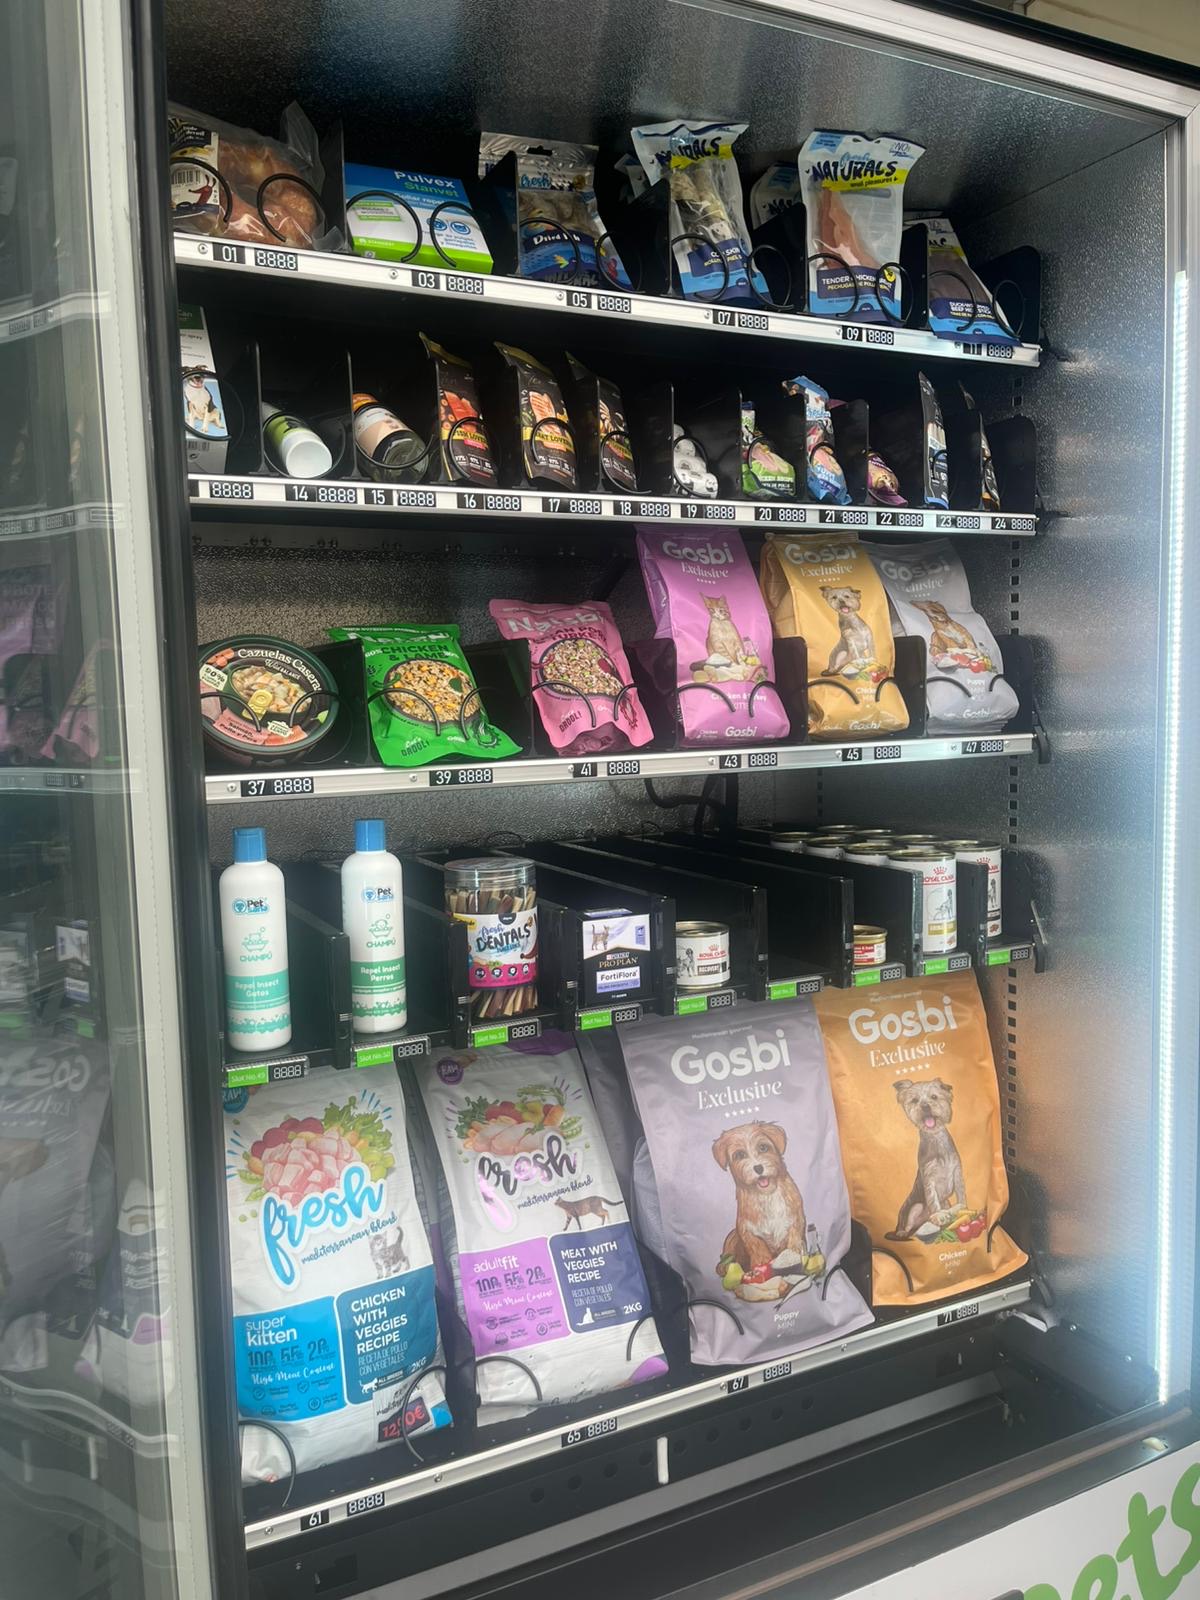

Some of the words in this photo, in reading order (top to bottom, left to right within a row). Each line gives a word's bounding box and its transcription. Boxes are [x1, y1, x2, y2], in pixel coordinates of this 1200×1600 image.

[812, 160, 898, 181] NATURALS
[394, 171, 456, 188] Pulvex
[404, 181, 458, 197] Stanvet
[222, 245, 237, 262] 01
[256, 249, 297, 270] 8888
[418, 272, 436, 288] 03
[447, 275, 483, 293] 8888
[821, 275, 850, 285] TENDER
[572, 292, 588, 307] 05
[599, 296, 631, 312] 8888
[718, 311, 732, 325] 07
[740, 314, 768, 329] 8888
[846, 327, 859, 341] 09
[867, 330, 893, 344] 8888
[988, 345, 1012, 358] 8888
[211, 482, 252, 498] 8888
[292, 485, 309, 501] 14
[318, 487, 356, 503] 8888
[372, 489, 386, 504] 15
[399, 491, 435, 507] 8888
[464, 495, 477, 508] 16
[487, 496, 520, 510] 8888
[549, 498, 561, 511] 17
[570, 499, 601, 514] 8888
[619, 501, 632, 515] 18
[640, 503, 670, 517] 8888
[686, 504, 698, 517] 19
[707, 504, 734, 519] 8888
[759, 507, 772, 521] 20
[779, 508, 805, 522] 8888
[825, 510, 836, 523] 21
[842, 511, 868, 524] 8888
[880, 512, 892, 525] 22
[898, 514, 923, 526] 8888
[940, 515, 952, 527] 23
[956, 516, 979, 528] 8888
[995, 517, 1006, 529] 24
[1011, 518, 1033, 531] 8888
[662, 541, 733, 565] Gosbi
[784, 544, 857, 565] Gosbi
[681, 561, 728, 579] Exclusive
[800, 564, 854, 578] Exclusive
[880, 559, 951, 580] Gosbi
[238, 649, 292, 664] Cazuelas
[381, 644, 449, 655] CHICKEN
[725, 726, 758, 737] Gosbi
[849, 720, 881, 731] Gosbi
[847, 749, 859, 760] 45
[876, 747, 900, 759] 8888
[966, 742, 977, 753] 47
[980, 740, 1003, 751] 8888
[580, 763, 592, 776] 41
[609, 761, 639, 774] 8888
[723, 755, 738, 768] 43
[750, 754, 777, 767] 8888
[436, 771, 452, 784] 39
[459, 769, 492, 783] 8888
[248, 781, 265, 795] 37
[274, 778, 312, 793] 8888
[247, 899, 264, 908] Pet
[366, 938, 396, 948] CHAMPÚ
[476, 923, 531, 953] DENTALS
[361, 966, 381, 976] Repel
[382, 964, 400, 973] Insect
[370, 974, 395, 982] Perros
[883, 968, 901, 980] 8888
[257, 979, 279, 988] Insect
[800, 982, 819, 994] 8888
[710, 996, 730, 1007] 8888
[615, 1010, 636, 1021] 8888
[848, 995, 958, 1045] Gosbi
[512, 1025, 535, 1038] 8888
[398, 1043, 423, 1057] 8888
[671, 1028, 791, 1085] Gosbi
[870, 1040, 946, 1069] Exclusive
[273, 1065, 301, 1078] 8888
[697, 1080, 783, 1110] Exclusive
[478, 1135, 577, 1230] fresh
[518, 1184, 569, 1210] mediterranean
[569, 1174, 593, 1193] blend
[263, 1165, 384, 1286] fresh
[301, 1229, 369, 1265] mediterranean
[369, 1214, 398, 1236] blend
[561, 1246, 587, 1260] MEAT
[590, 1241, 618, 1256] WITH
[938, 1250, 967, 1262] Chicken
[564, 1256, 606, 1272] VEGGIES
[568, 1269, 601, 1284] RECIPE
[351, 1286, 406, 1312] CHICKEN
[353, 1307, 388, 1326] WITH
[624, 1302, 643, 1315] 2KG
[774, 1310, 800, 1323] Puppy
[943, 1311, 953, 1323] 71
[957, 1303, 979, 1320] 8888
[246, 1315, 286, 1332] super
[355, 1314, 409, 1340] VEGGIES
[247, 1326, 298, 1347] kitten
[357, 1332, 401, 1355] RECIPE
[410, 1356, 427, 1373] 2KG
[732, 1377, 745, 1391] 67
[765, 1362, 791, 1379] 8888
[567, 1430, 581, 1444] 65
[588, 1419, 616, 1437] 8888
[309, 1512, 322, 1527] 61
[349, 1492, 383, 1513] 8888
